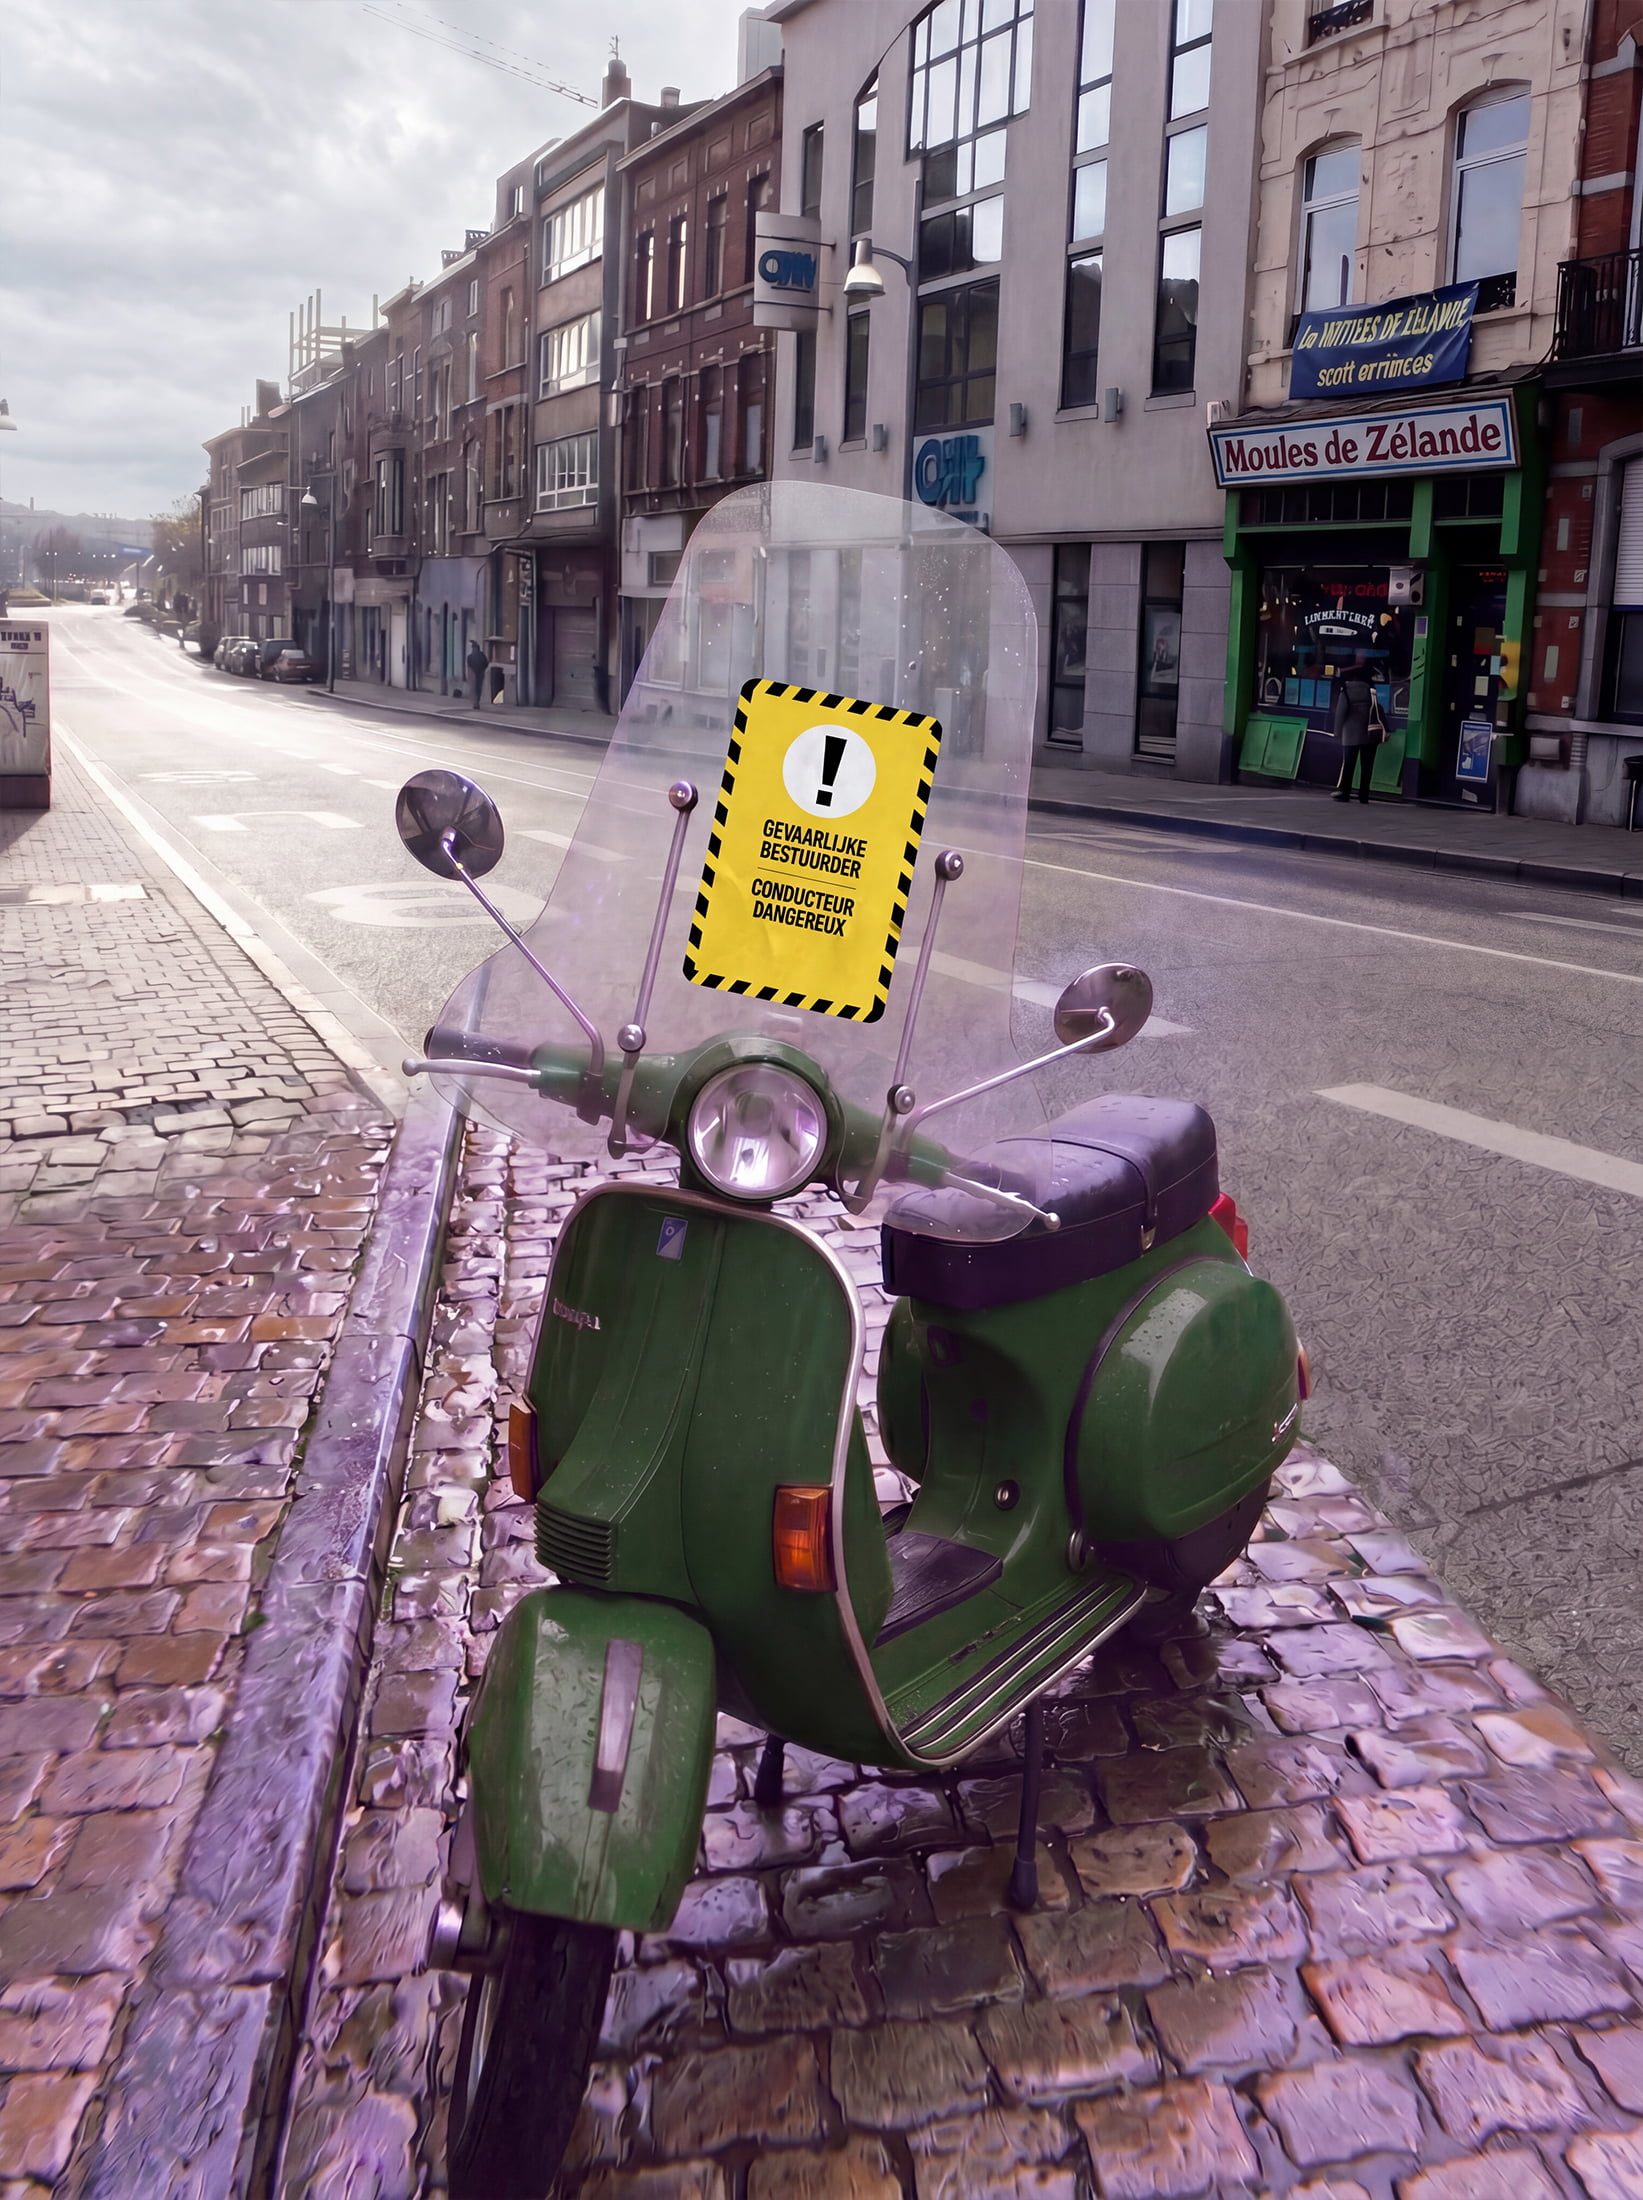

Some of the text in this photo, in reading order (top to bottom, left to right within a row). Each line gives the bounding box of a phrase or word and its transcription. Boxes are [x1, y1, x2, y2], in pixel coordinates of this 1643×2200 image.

[1225, 415, 1501, 473] Moules de Zélande
[763, 819, 868, 858] GEVAARLIJKE
[760, 841, 861, 879] BESTUURDER
[751, 878, 855, 917] CONDUCTEUR
[752, 900, 847, 937] DANGEREUX
